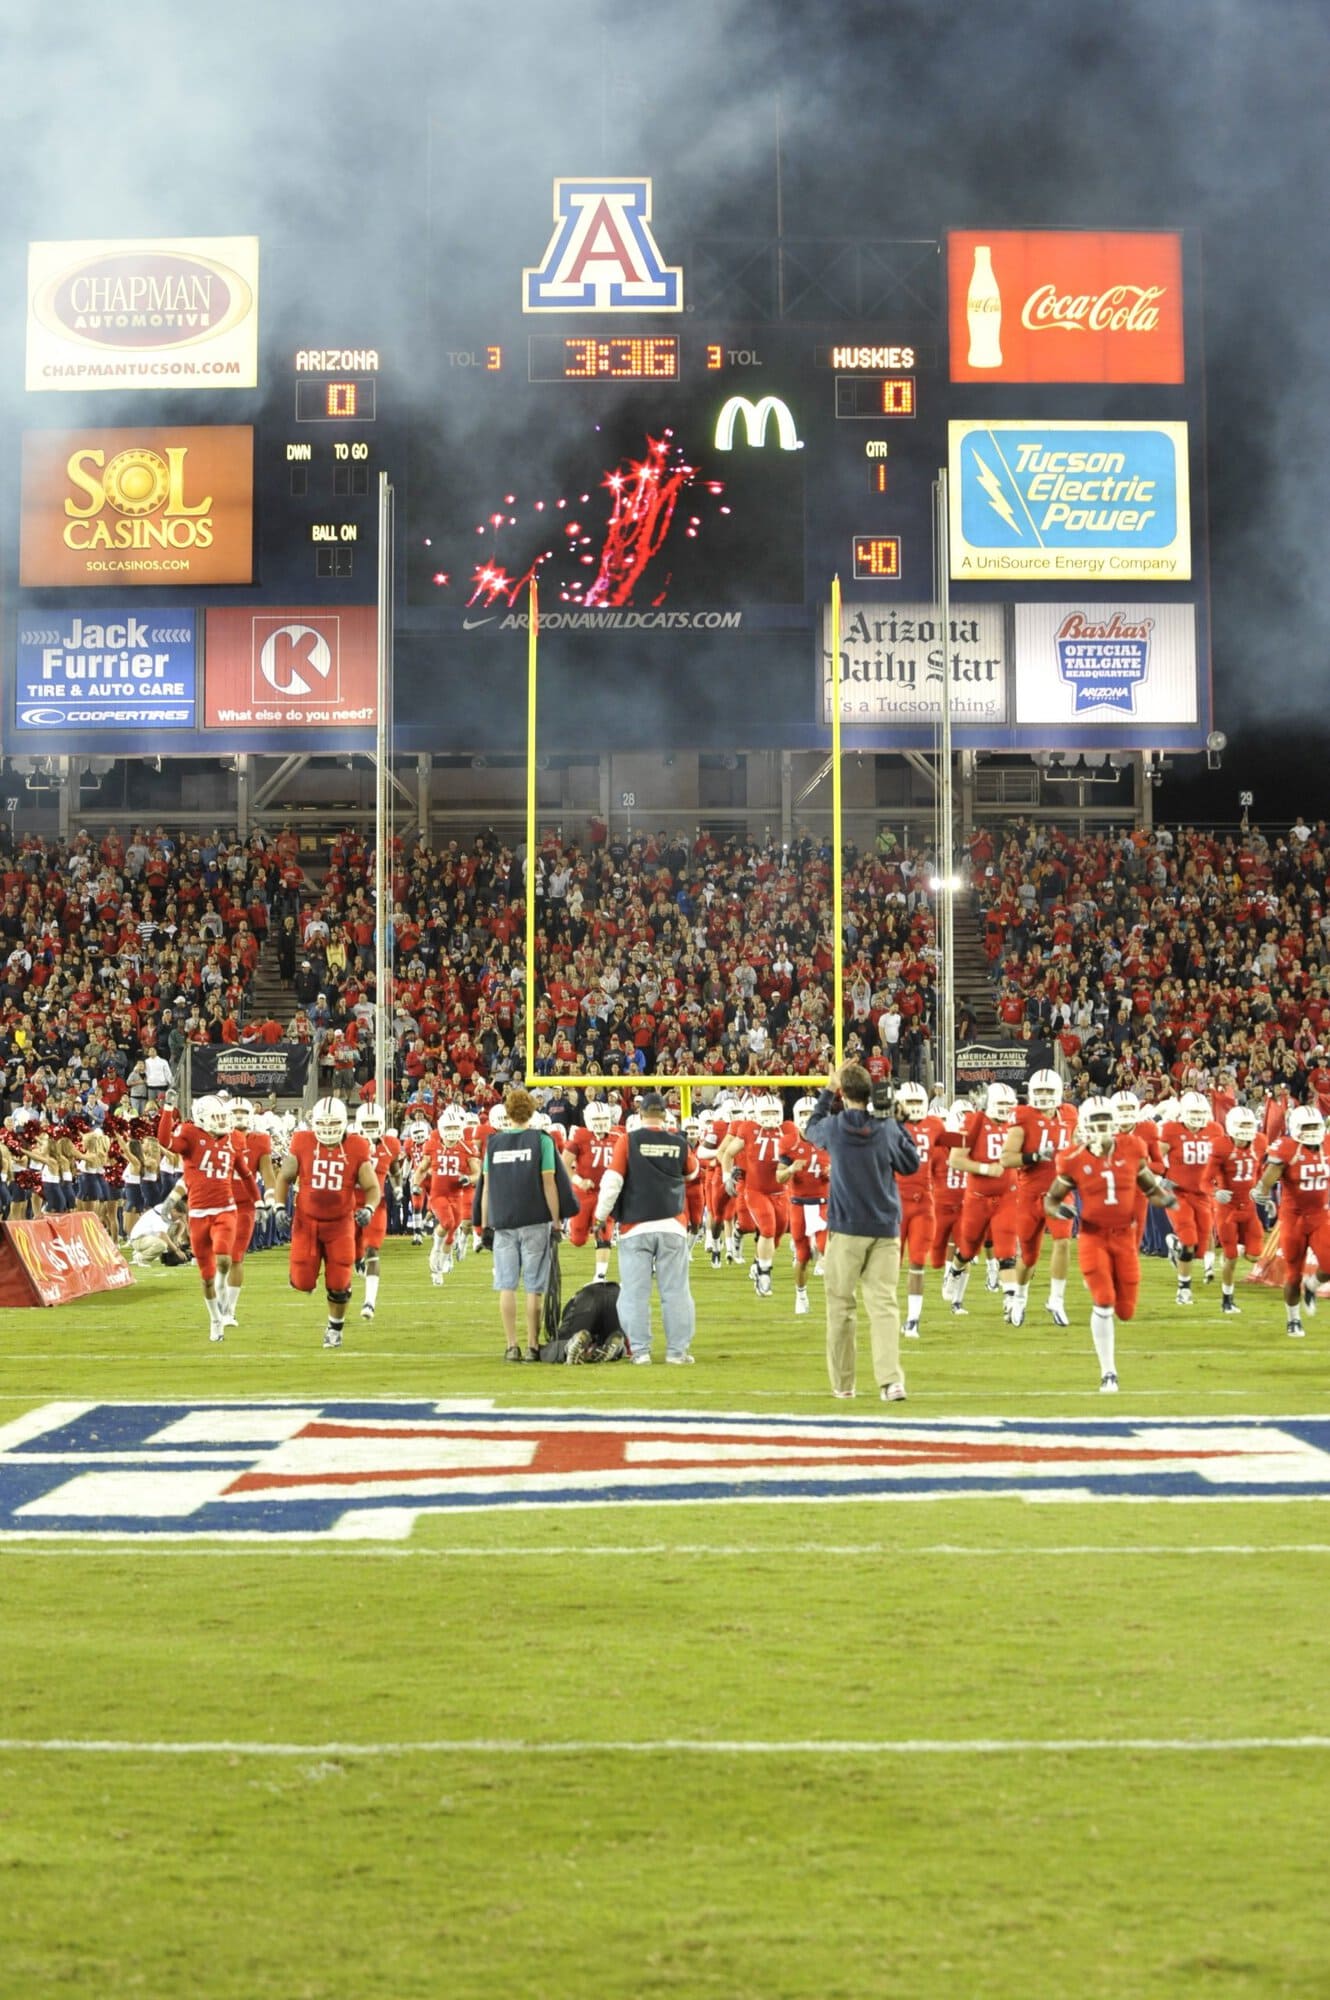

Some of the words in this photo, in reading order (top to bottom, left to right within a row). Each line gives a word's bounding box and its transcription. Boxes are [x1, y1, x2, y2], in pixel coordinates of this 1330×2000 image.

[70, 274, 213, 314] CHAPMAN
[1021, 284, 1167, 332] Coca-Cola
[74, 313, 210, 329] AUTOMOTIVE
[295, 350, 379, 371] ARIZONA
[447, 352, 481, 367] TOL
[486, 346, 501, 369] 3
[565, 338, 675, 376] 3:36
[706, 345, 721, 369] 3
[728, 350, 762, 366] TOL
[832, 346, 915, 369] HUSKIES
[42, 361, 241, 378] CHAPMANTUCSON.COM
[327, 383, 356, 417] 0
[883, 380, 912, 413] 0
[286, 443, 312, 461] DWN
[334, 442, 349, 460] TO
[351, 442, 368, 460] GO
[865, 440, 888, 458] QTR
[1015, 443, 1126, 474] Tucson
[64, 448, 213, 518] SOL
[878, 463, 886, 492] 1
[1027, 475, 1155, 502] Electric
[1040, 503, 1155, 532] Power
[63, 518, 214, 550] CASINOS
[312, 524, 338, 542] BALL
[341, 523, 357, 541] ON
[86, 559, 190, 572] SOLCASINOS.COM
[857, 541, 897, 574] 40
[961, 557, 972, 569] A
[976, 555, 1051, 570] UniSource
[1055, 556, 1105, 572] Energy
[1109, 556, 1177, 572] Company
[500, 611, 742, 630] ARZONAWILDCATS.COM
[63, 617, 149, 651] Jack
[1064, 644, 1142, 657] OFFICIAL
[42, 649, 170, 680] Furrier
[1064, 657, 1142, 670] TAILGATE
[1065, 669, 1141, 680] HEADQUARTERS
[27, 684, 66, 698] TIRE
[70, 684, 83, 696] &
[88, 683, 136, 697] AUTO
[139, 683, 185, 696] CARE
[1078, 687, 1130, 697] ARIZONA
[859, 701, 870, 713] a
[876, 696, 942, 713] Tucson
[217, 709, 252, 722] What
[255, 708, 282, 721] else
[286, 709, 303, 721] do
[305, 710, 330, 724] you
[332, 708, 374, 720] need?
[7, 797, 19, 811] 27
[623, 792, 635, 806] 28
[1240, 791, 1253, 806] 29
[217, 1056, 257, 1064] AMERICAN
[259, 1055, 288, 1063] FAMILY
[999, 1052, 1027, 1060] FAMILY
[493, 1148, 532, 1165] ESPN
[639, 1143, 681, 1159] ESPN
[1183, 1141, 1212, 1165] 68
[199, 1149, 231, 1179] 43
[436, 1155, 460, 1177] 33
[1232, 1159, 1255, 1182] 11
[311, 1159, 345, 1191] 55
[1299, 1164, 1330, 1191] 52
[1100, 1170, 1119, 1206] 1
